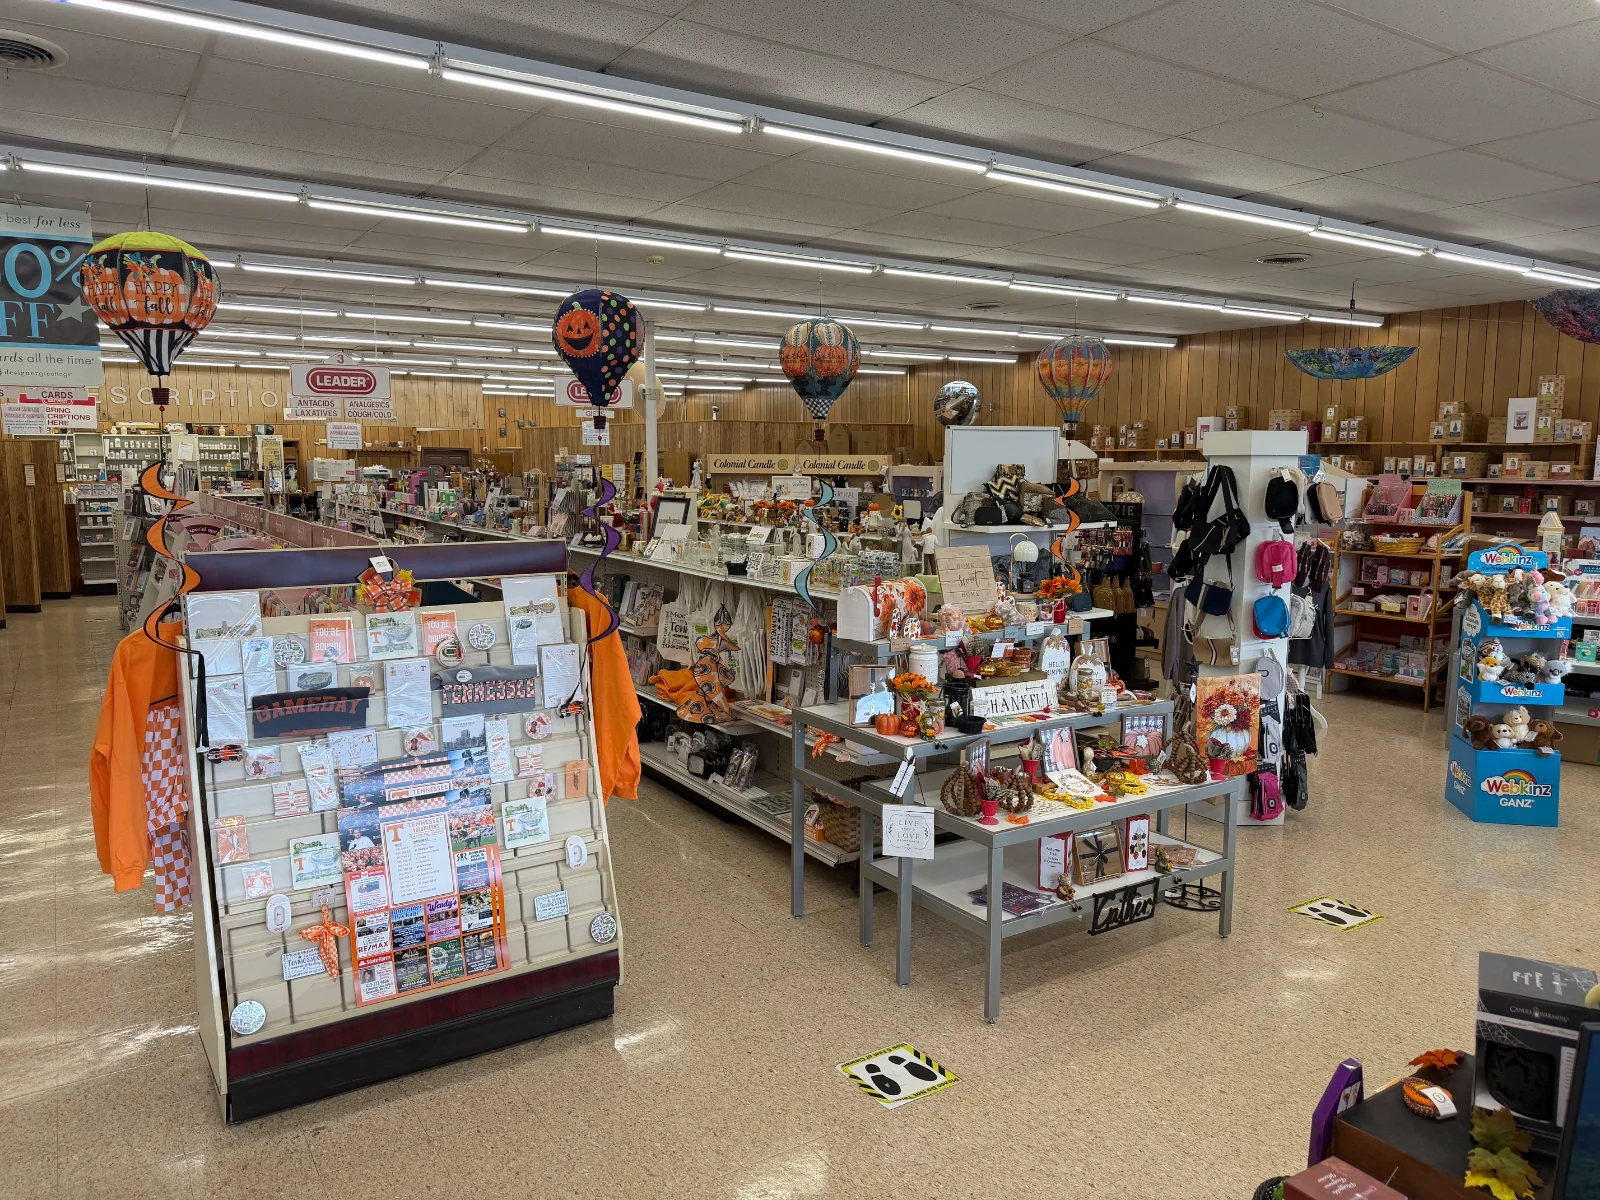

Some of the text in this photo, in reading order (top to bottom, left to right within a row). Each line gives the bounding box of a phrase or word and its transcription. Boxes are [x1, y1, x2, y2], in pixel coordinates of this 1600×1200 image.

[6, 212, 31, 225] best
[34, 216, 54, 229] for
[87, 281, 178, 298] HAPPY HAPPY
[95, 296, 118, 315] fall
[136, 296, 174, 315] fall
[27, 353, 41, 363] all
[45, 354, 63, 364] the
[337, 354, 345, 364] 3
[316, 375, 367, 388] LEADER
[41, 391, 73, 399] CARDS
[349, 401, 390, 409] ANALGESICS
[295, 410, 338, 418] LAXATIVES
[347, 411, 392, 419] COUGH/COLD
[714, 458, 776, 470] Colonial Candle
[803, 459, 866, 471] Colonial Candle
[1484, 553, 1533, 565] Webkinz
[315, 628, 340, 636] YOU'RE
[370, 631, 382, 644] T
[442, 677, 536, 705] TENNESSEE
[1504, 687, 1543, 698] Webkinz
[990, 691, 1051, 714] HANKFUL
[255, 695, 360, 723] GAMEDAY
[364, 734, 373, 743] T
[412, 784, 448, 795] TENNESSEE
[1487, 779, 1551, 797] Webkinz
[1500, 798, 1532, 808] GANZ
[407, 816, 444, 828] TENNESSEE
[505, 819, 516, 832] T
[386, 824, 405, 843] T
[897, 832, 920, 840] LOVE
[294, 858, 305, 872] T
[426, 897, 457, 912] Wendy's
[358, 941, 389, 954] RE/MAX
